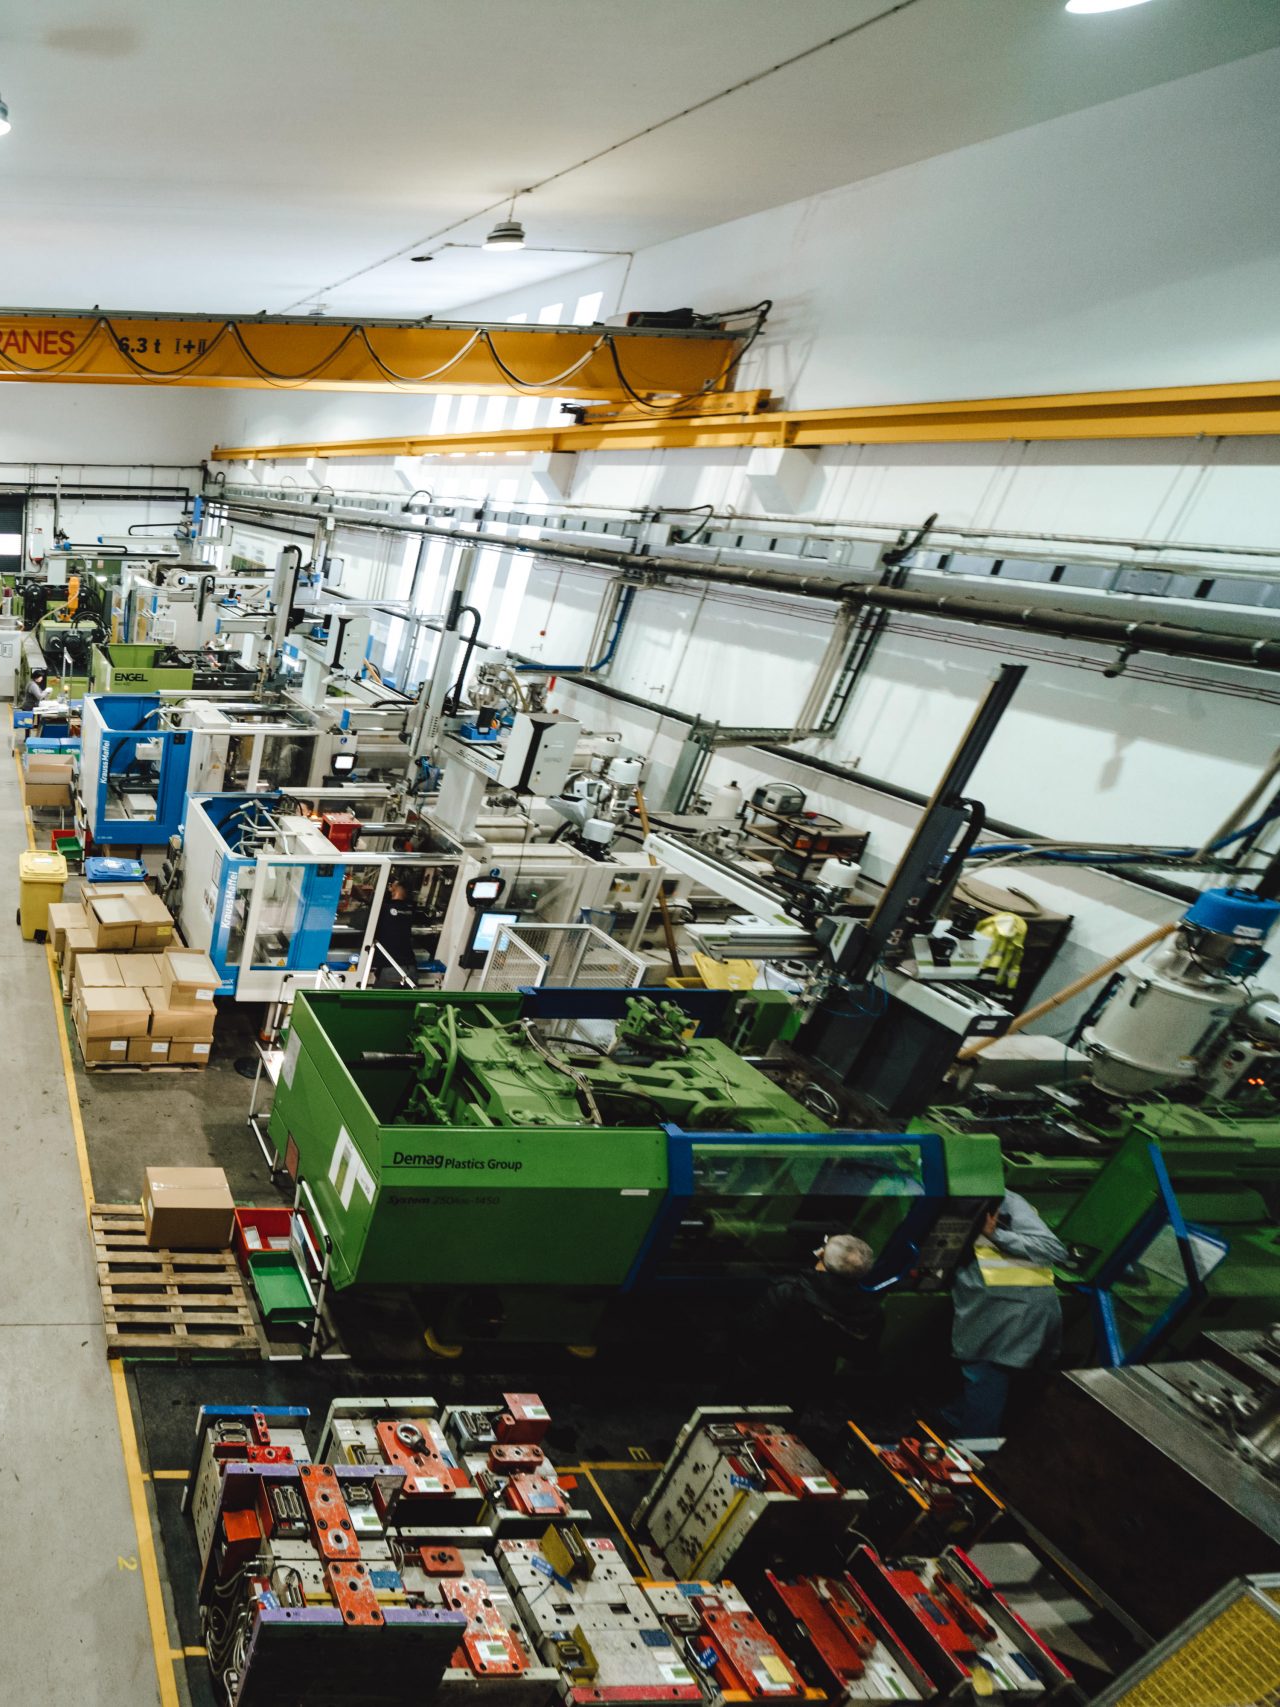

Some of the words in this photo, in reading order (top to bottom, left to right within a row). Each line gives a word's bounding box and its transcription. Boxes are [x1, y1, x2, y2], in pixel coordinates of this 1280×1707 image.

[120, 337, 148, 354] 6.3
[154, 339, 161, 354] t
[115, 672, 148, 682] ENGEL
[393, 1151, 444, 1168] Demag
[445, 1159, 485, 1170] Plastics
[488, 1160, 523, 1172] Group
